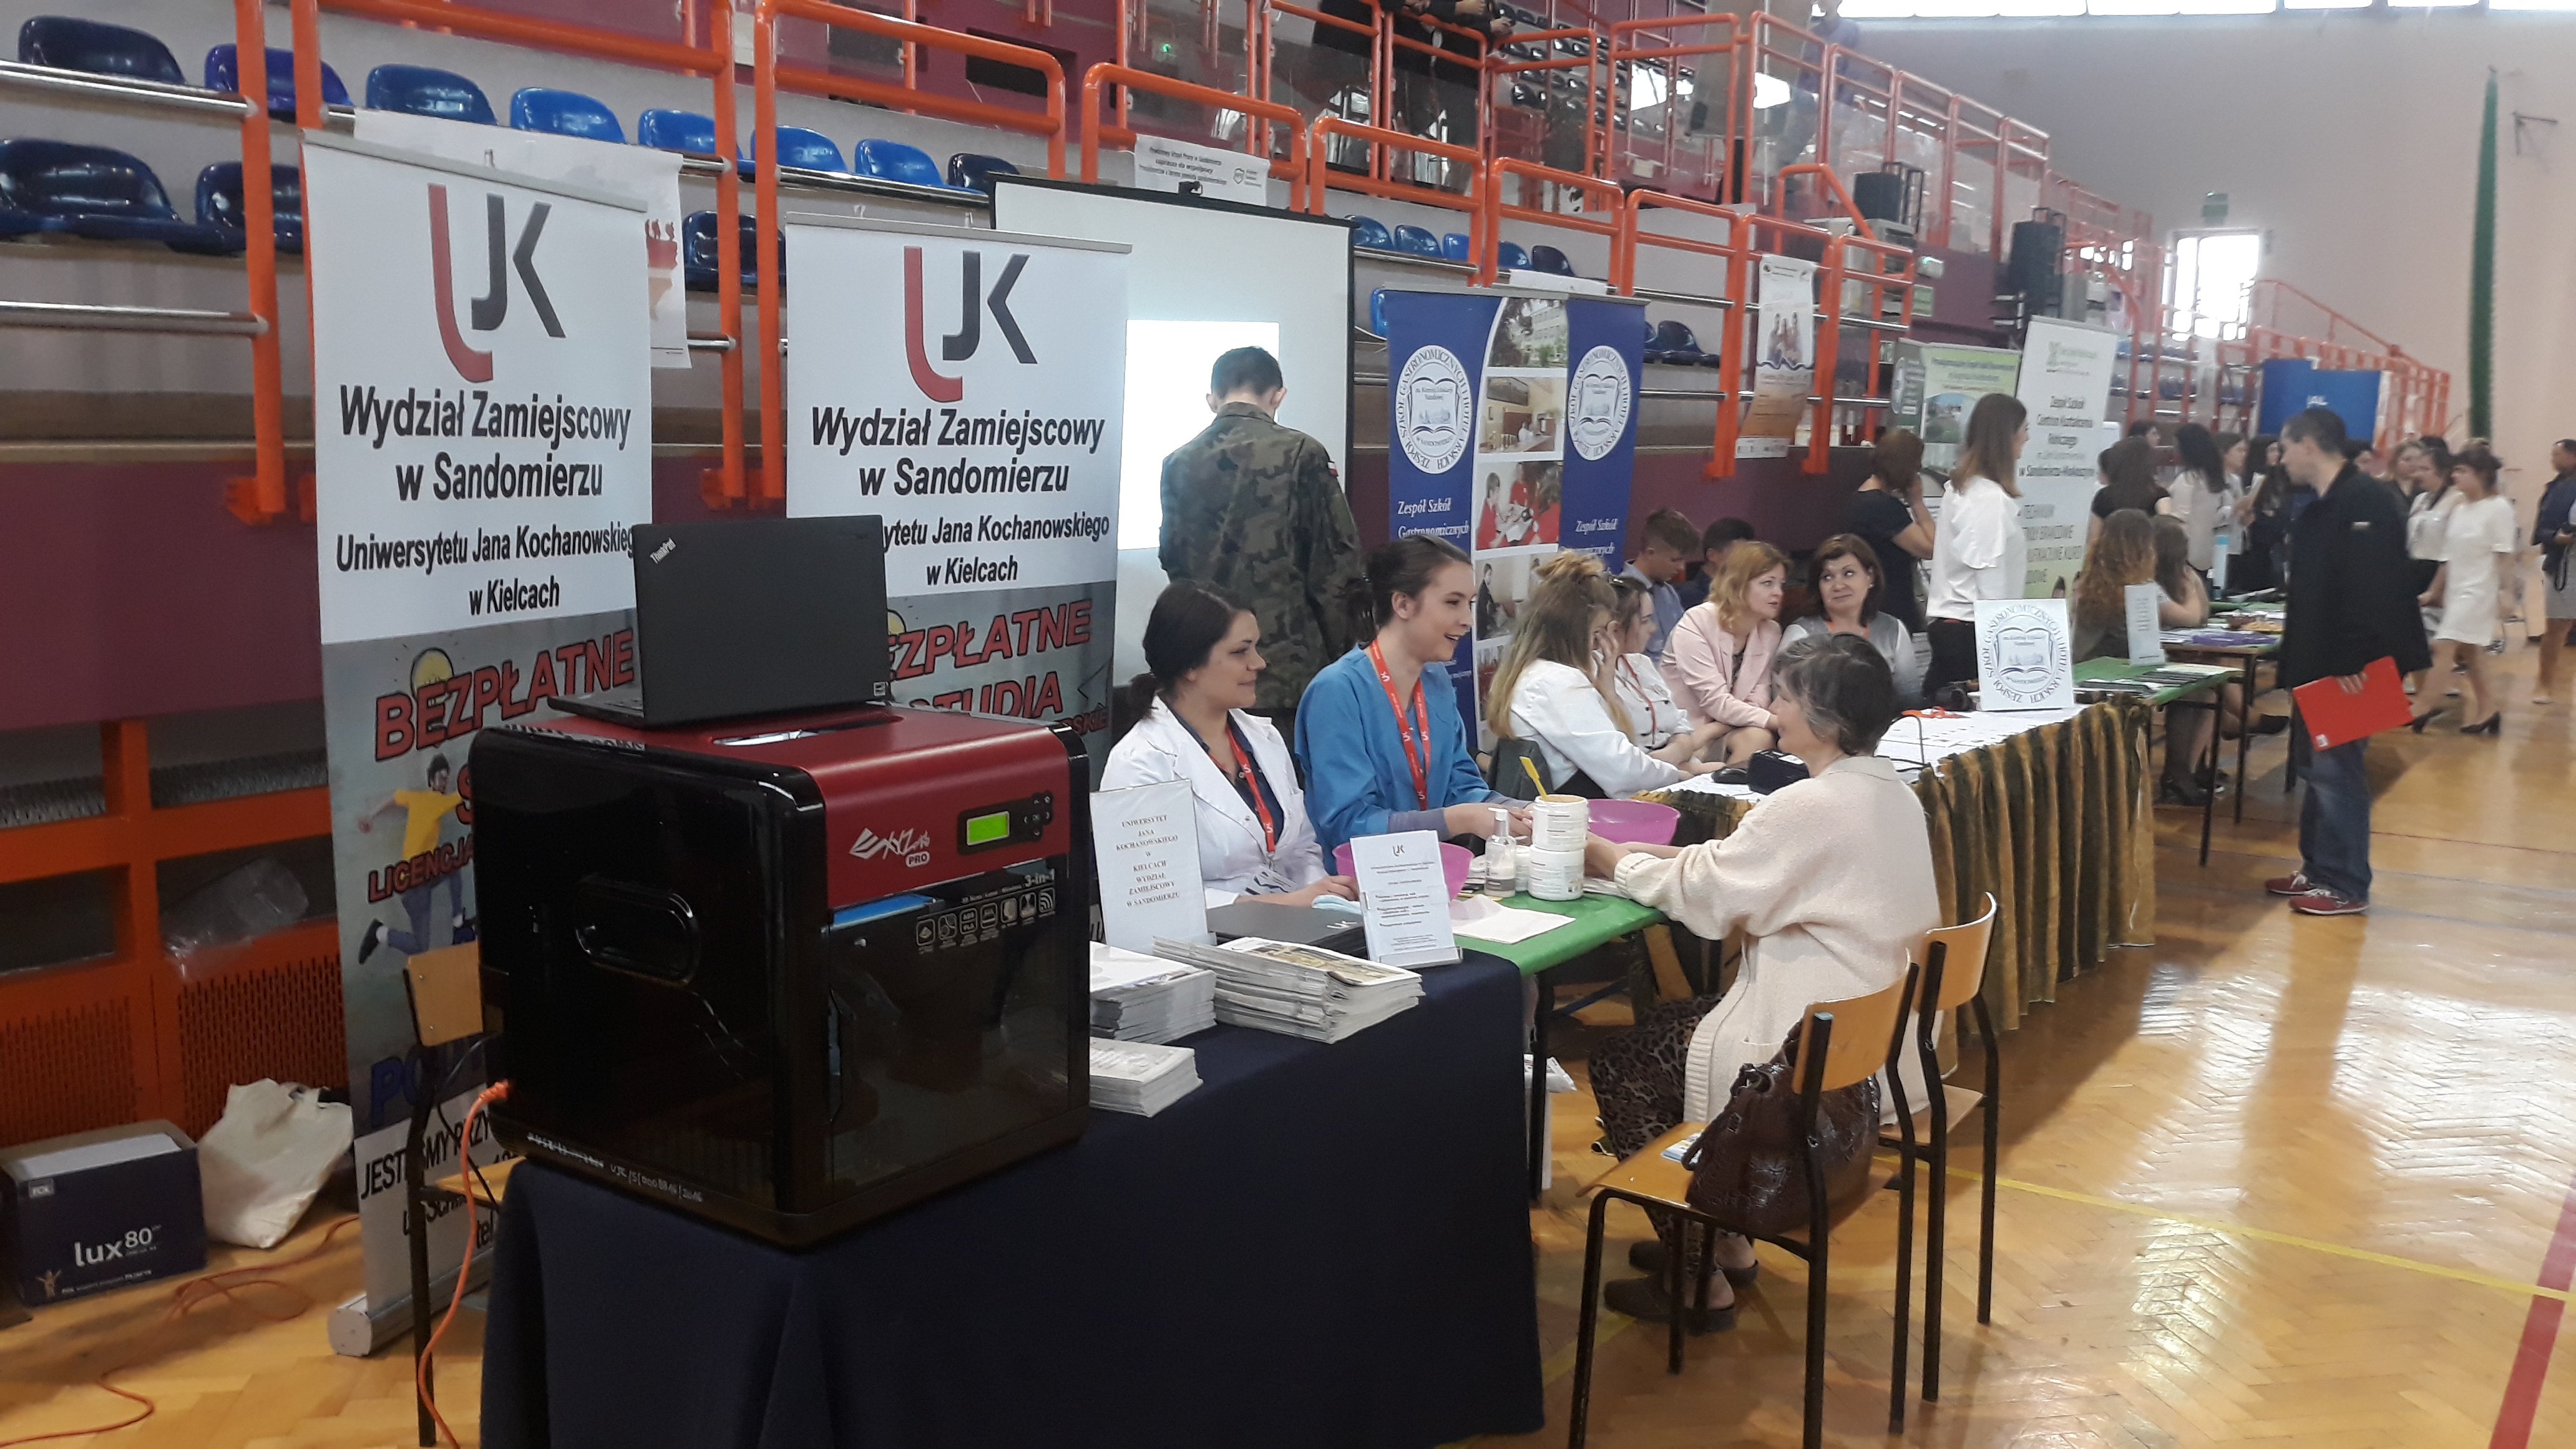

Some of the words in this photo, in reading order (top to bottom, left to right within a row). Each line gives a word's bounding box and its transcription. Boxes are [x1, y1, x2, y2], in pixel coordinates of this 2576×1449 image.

[340, 384, 464, 449] Wydział
[471, 390, 631, 451] Zamiejscowy
[812, 406, 932, 456] Wydział
[937, 407, 1105, 454] Zamiejscowy
[396, 464, 424, 500] w
[433, 451, 603, 500] Sandomierzu
[859, 467, 886, 495] w
[894, 457, 1070, 495] Sandomierzu
[932, 517, 972, 544] Jana
[977, 511, 1110, 542] Kochanowskiego
[1397, 499, 1427, 517] Zespół
[336, 530, 468, 575] Uniwersytetu
[472, 527, 510, 562] Jana
[516, 521, 634, 560] Kochanowskieg
[927, 564, 942, 586] w
[945, 554, 1018, 585] Kielcach
[469, 589, 482, 616] w
[486, 575, 560, 614] Kielcach
[888, 598, 1092, 681] ZPŁATNE
[376, 628, 635, 762] BEZPŁATNE
[909, 671, 1063, 717] UDIA
[908, 853, 928, 865] PRO
